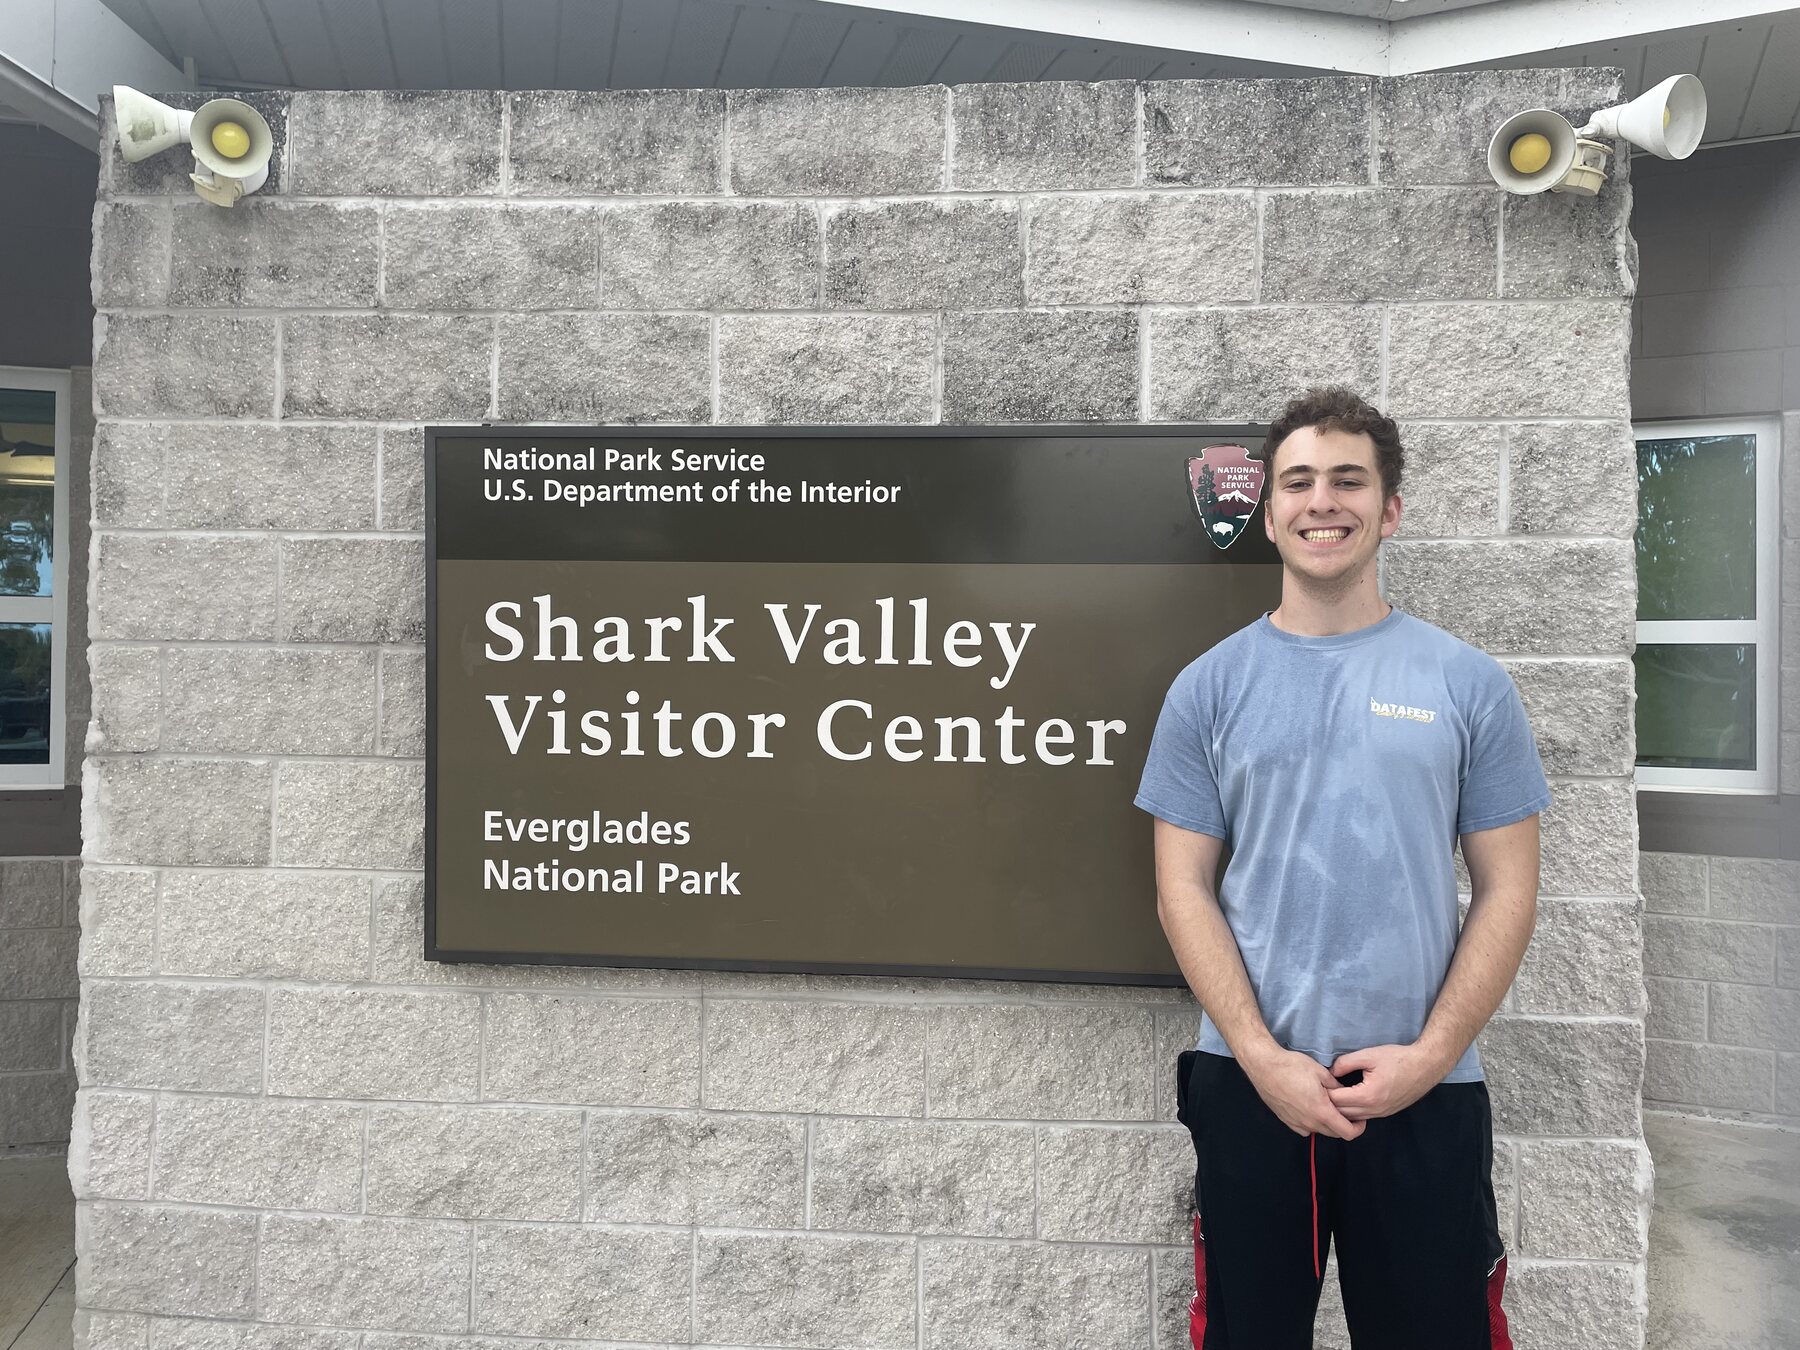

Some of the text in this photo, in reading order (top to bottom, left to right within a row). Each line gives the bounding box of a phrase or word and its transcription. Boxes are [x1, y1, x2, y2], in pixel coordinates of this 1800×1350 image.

[484, 448, 765, 472] National Park Service
[1217, 466, 1260, 474] NATIONAL
[484, 479, 901, 508] U.S. Department of the Interior
[1221, 481, 1255, 489] SERVICE
[484, 593, 1037, 689] Shark Valley
[484, 690, 1127, 766] Visitor Center
[483, 810, 691, 851] Everglades
[483, 858, 742, 897] National Park
